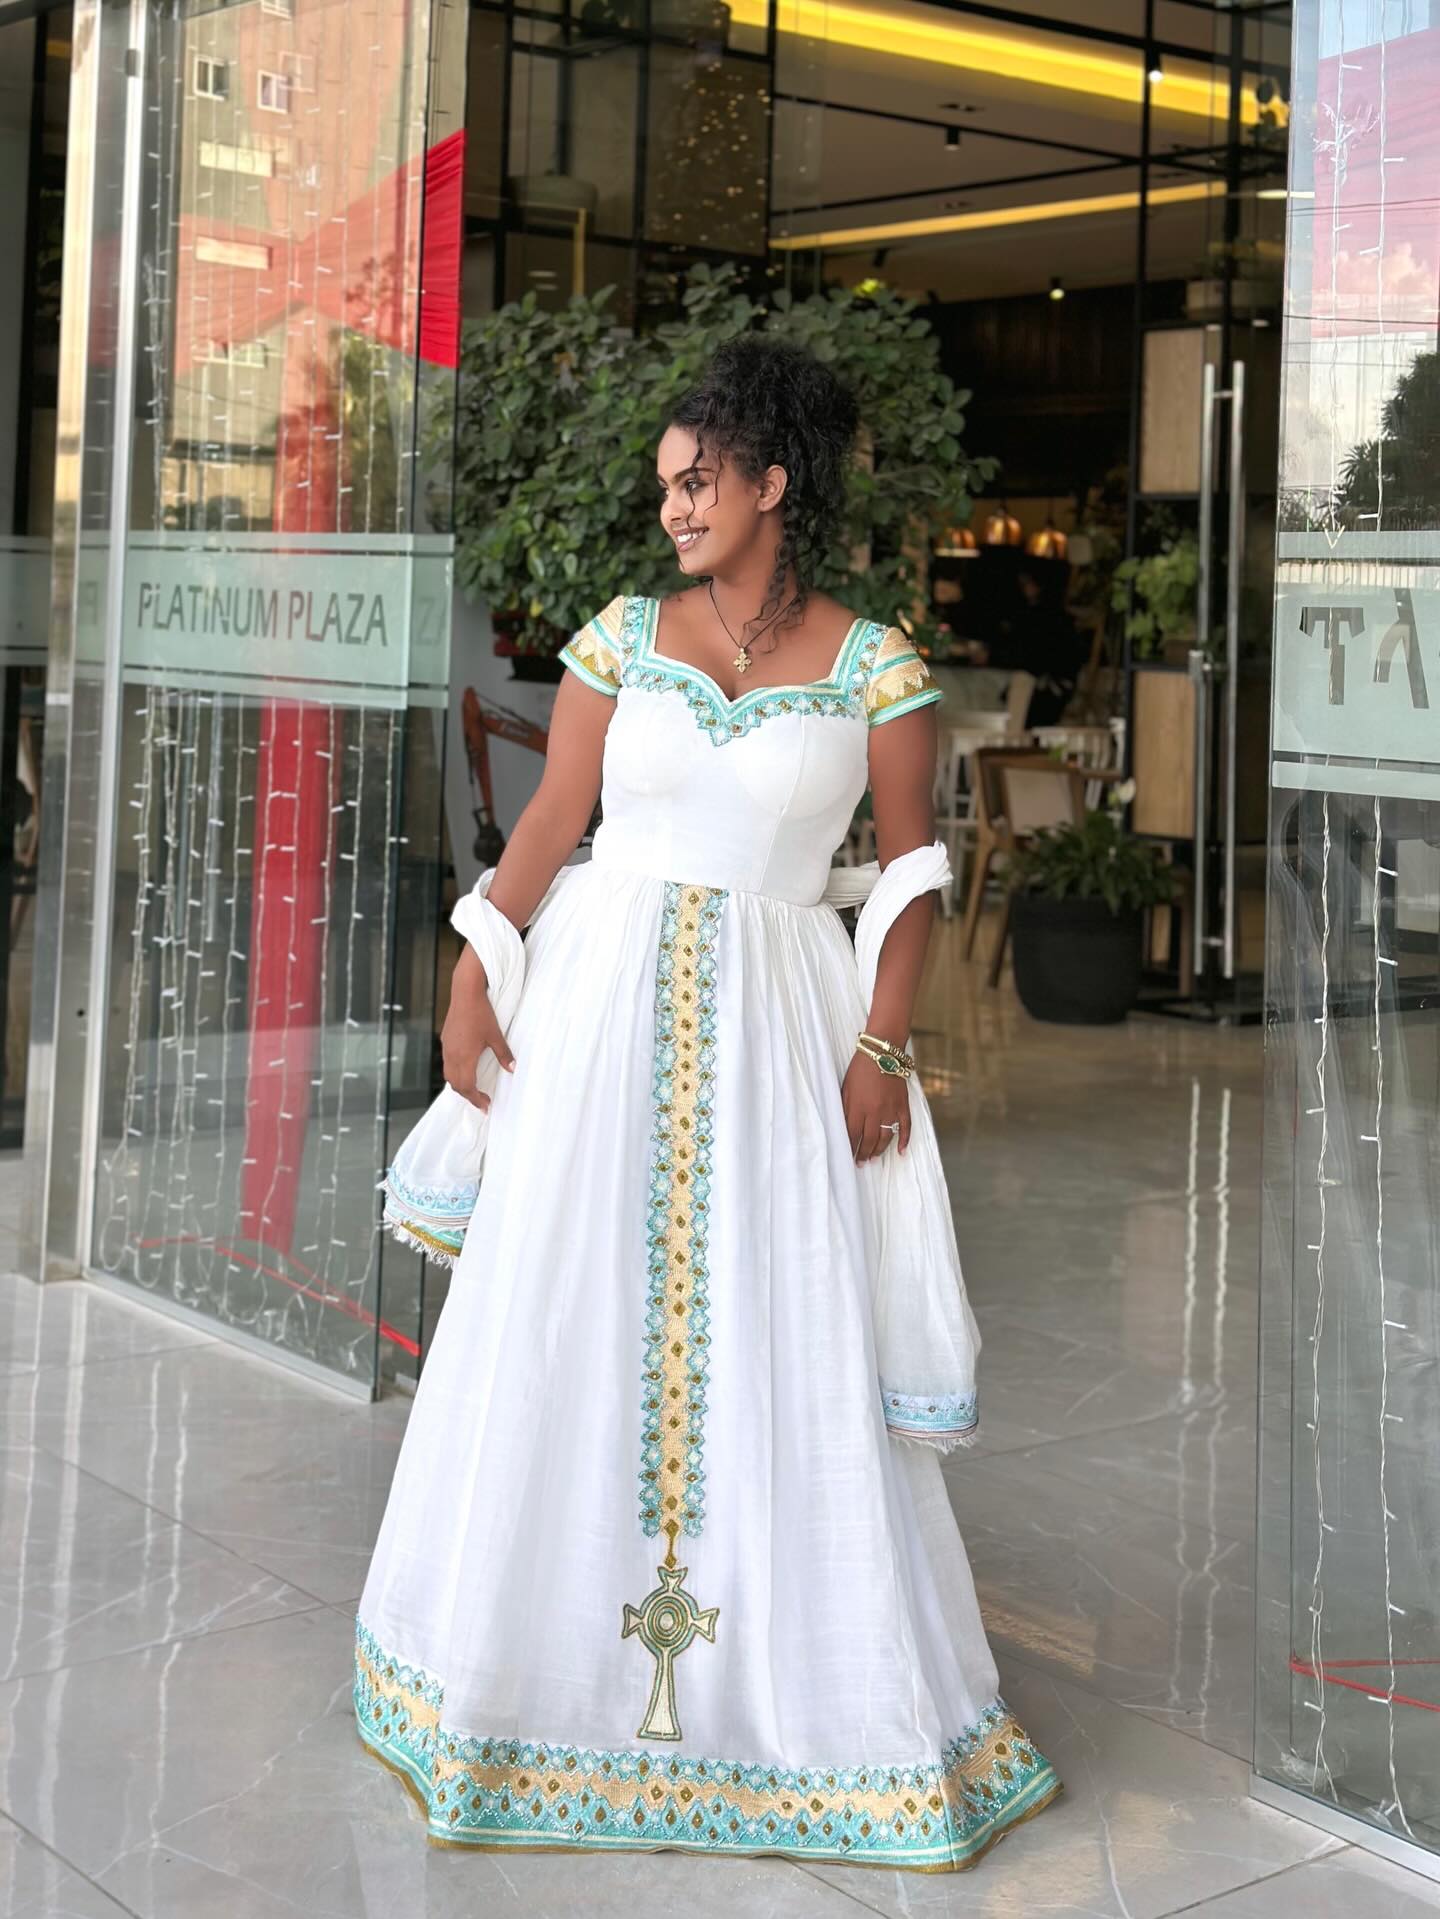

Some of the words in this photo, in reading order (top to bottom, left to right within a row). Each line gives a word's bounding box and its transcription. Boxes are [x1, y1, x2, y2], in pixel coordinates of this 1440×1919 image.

[138, 582, 279, 639] PLATINUM
[287, 590, 388, 647] PLAZA
[1299, 588, 1440, 708] ፕላ
